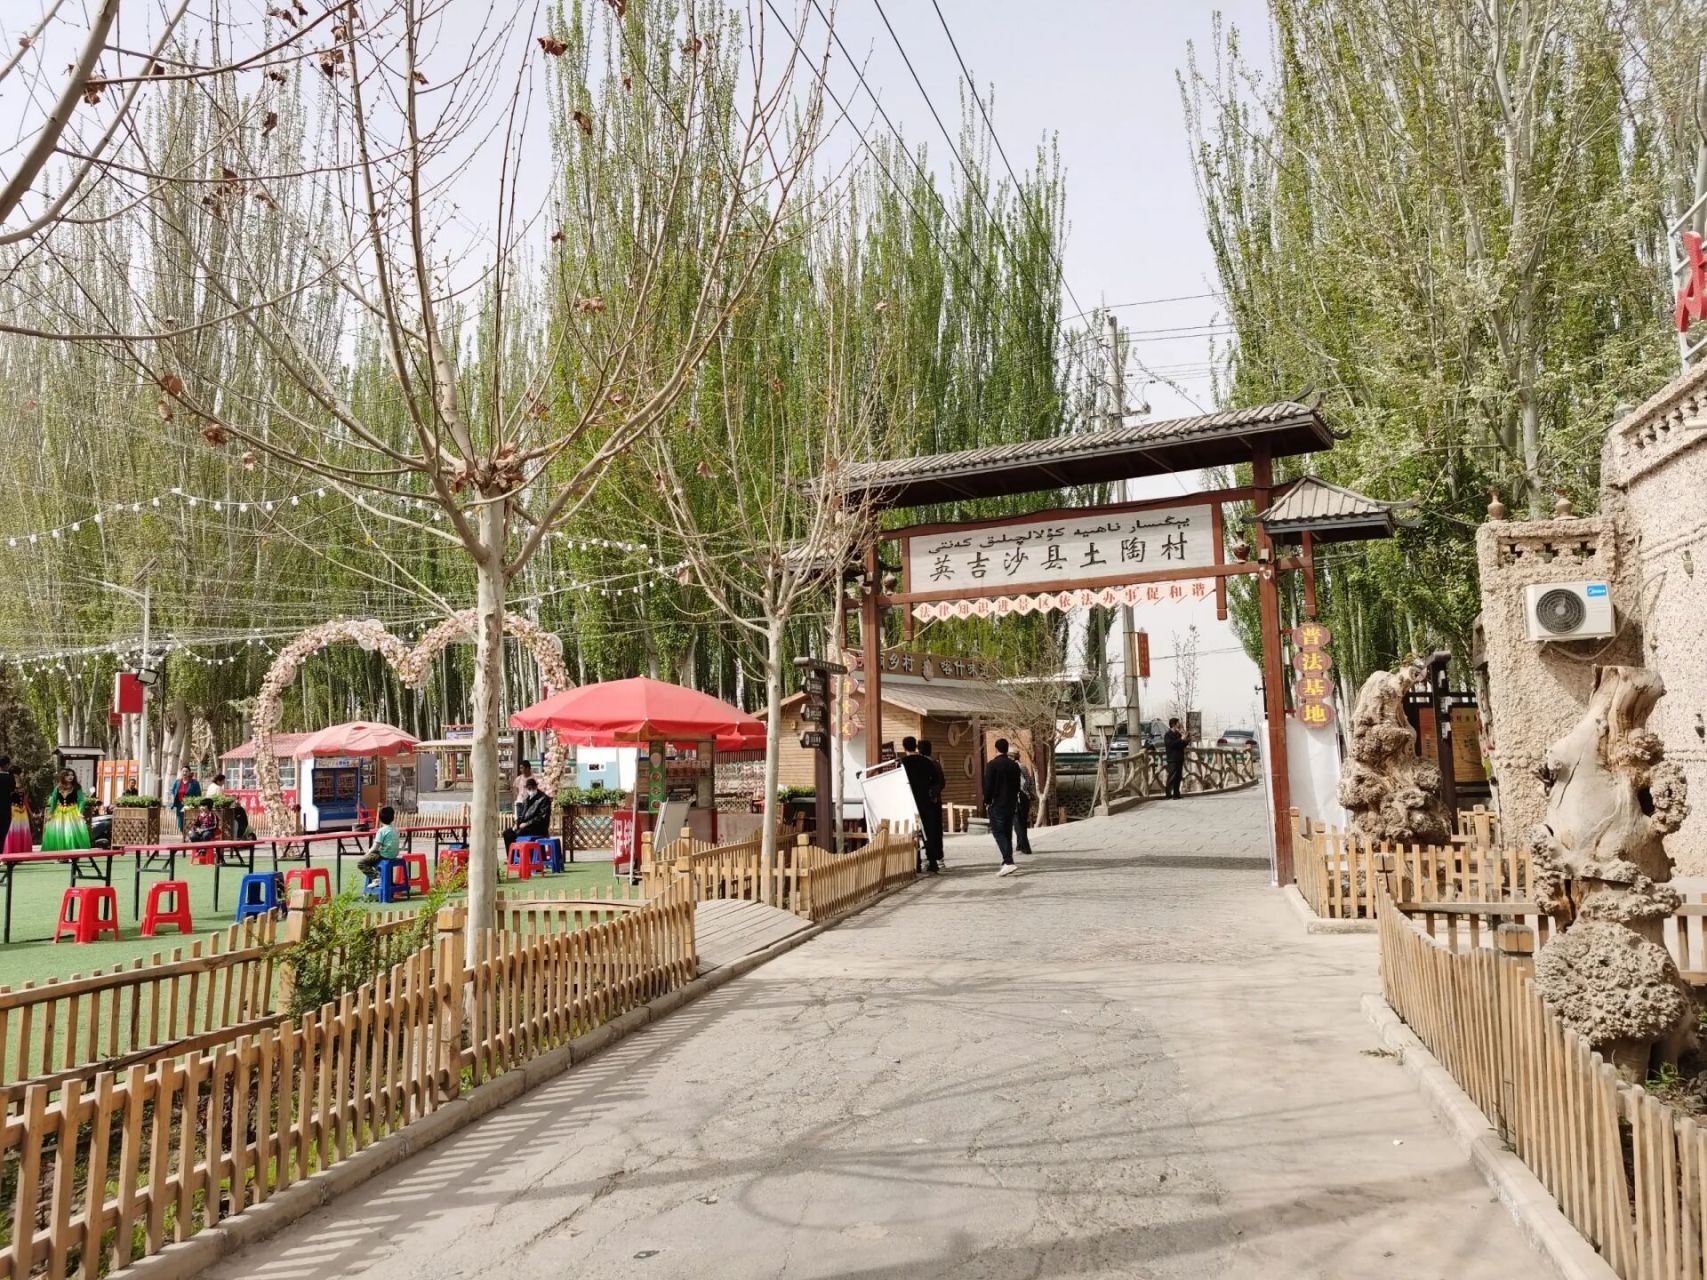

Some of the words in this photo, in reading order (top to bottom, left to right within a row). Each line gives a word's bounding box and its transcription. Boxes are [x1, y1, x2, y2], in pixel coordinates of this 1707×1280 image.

[930, 531, 1188, 582] 英吉沙县土陶村
[919, 583, 1206, 618] 法律知识进景区依法办事促和谐
[1301, 626, 1327, 723] 普法基地
